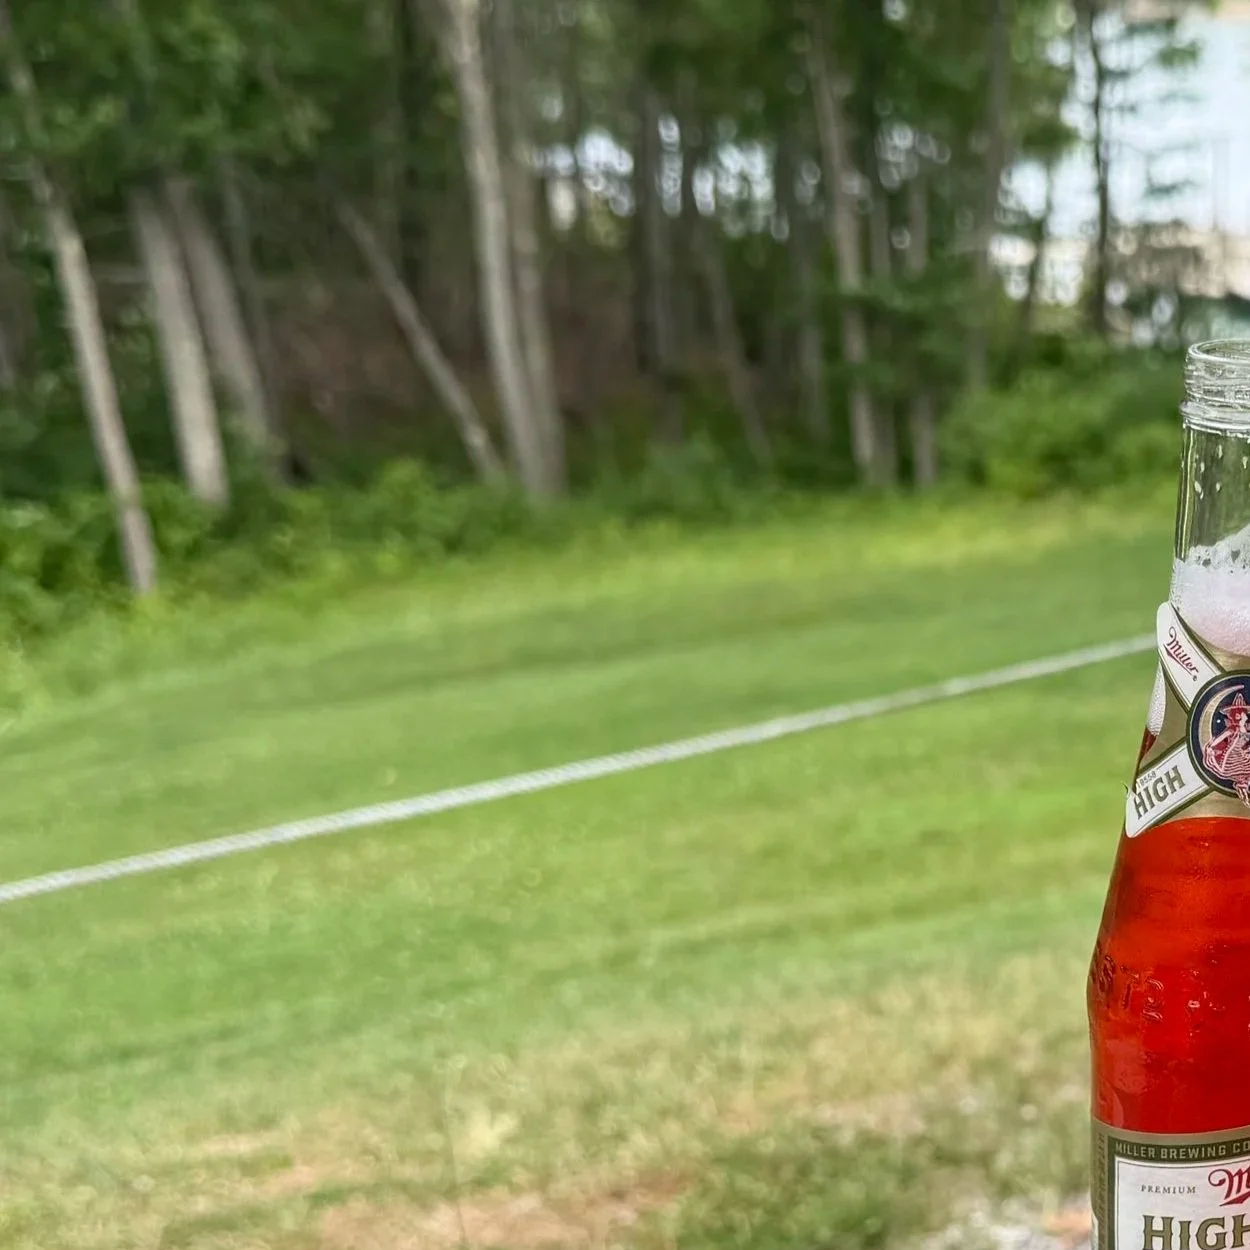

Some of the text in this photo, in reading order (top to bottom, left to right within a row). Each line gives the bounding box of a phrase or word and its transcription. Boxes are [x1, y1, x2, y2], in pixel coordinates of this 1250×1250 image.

[1164, 625, 1198, 678] Miller
[1134, 765, 1186, 820] HIGH
[1115, 1142, 1155, 1158] MILLER
[1160, 1143, 1226, 1159] BREWING
[1140, 1183, 1197, 1195] PREMIUM
